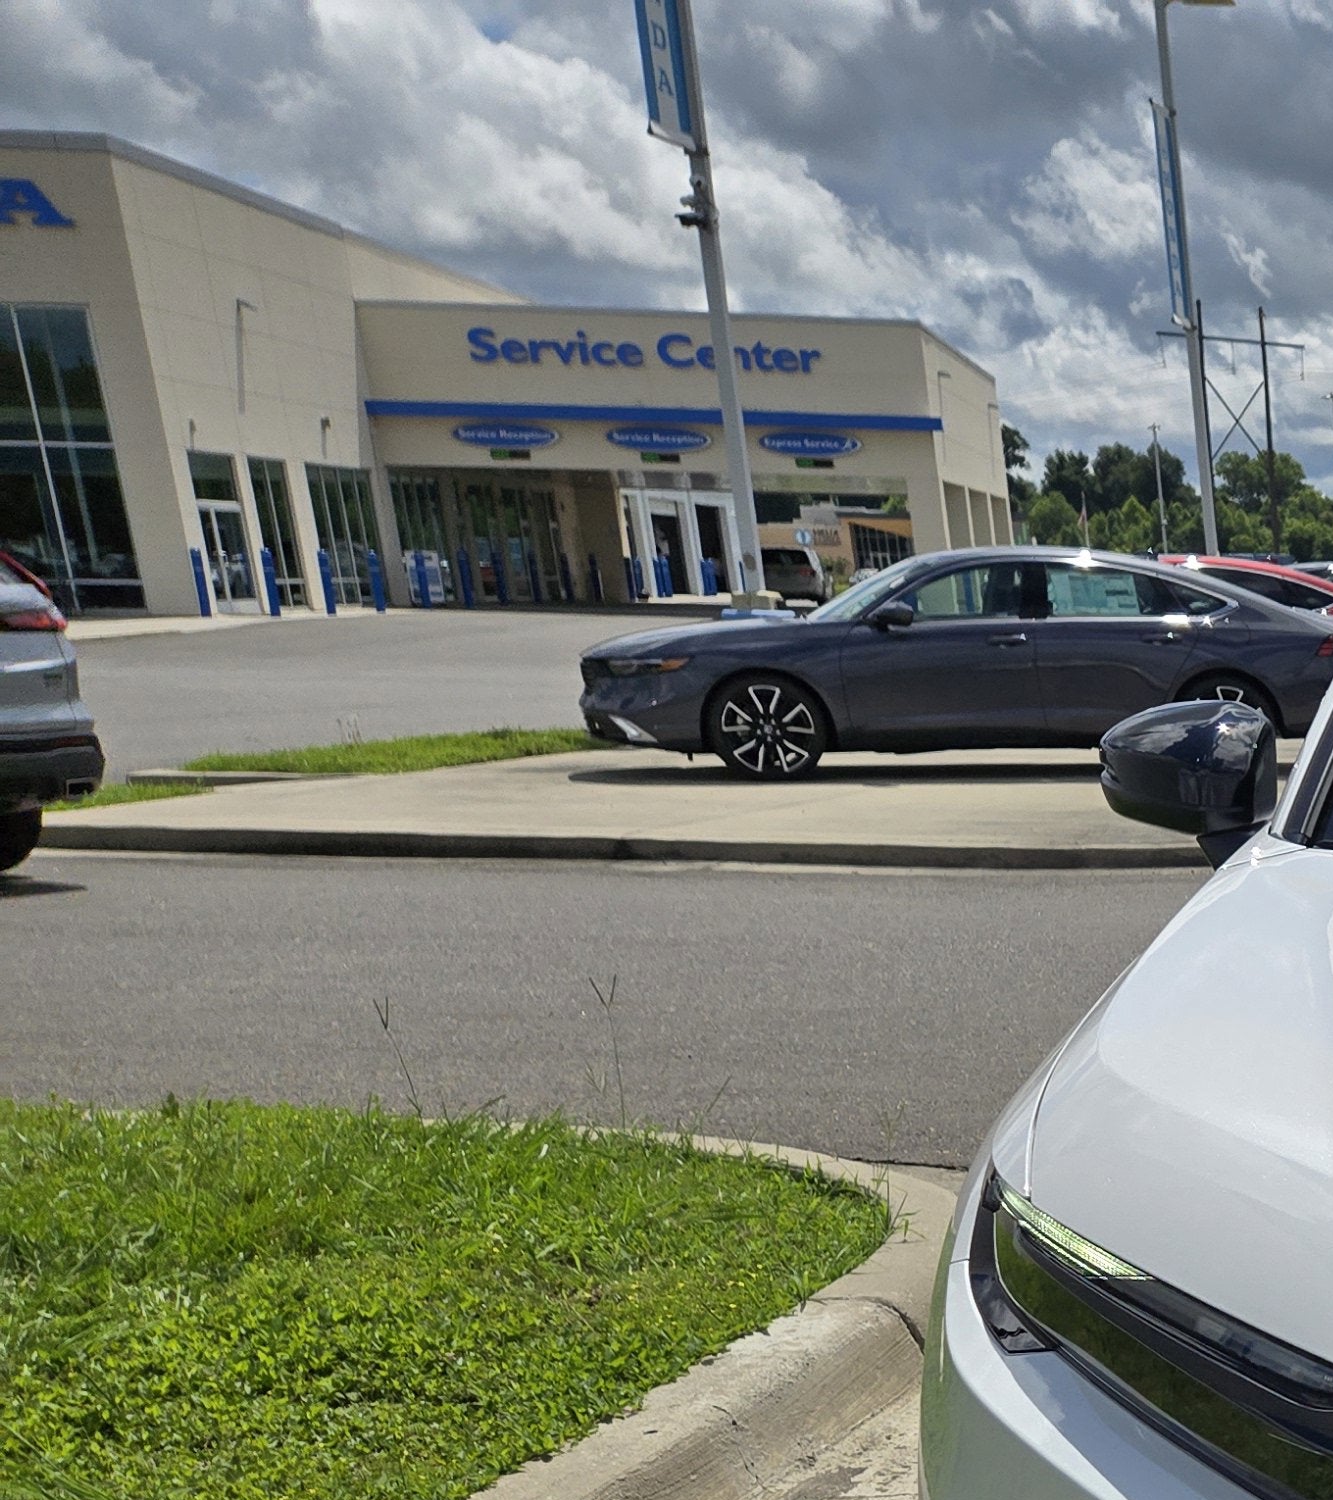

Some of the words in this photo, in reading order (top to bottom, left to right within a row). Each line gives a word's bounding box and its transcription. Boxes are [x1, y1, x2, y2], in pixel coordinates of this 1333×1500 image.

[650, 0, 675, 97] DA
[466, 326, 645, 369] Service
[656, 332, 822, 374] Center
